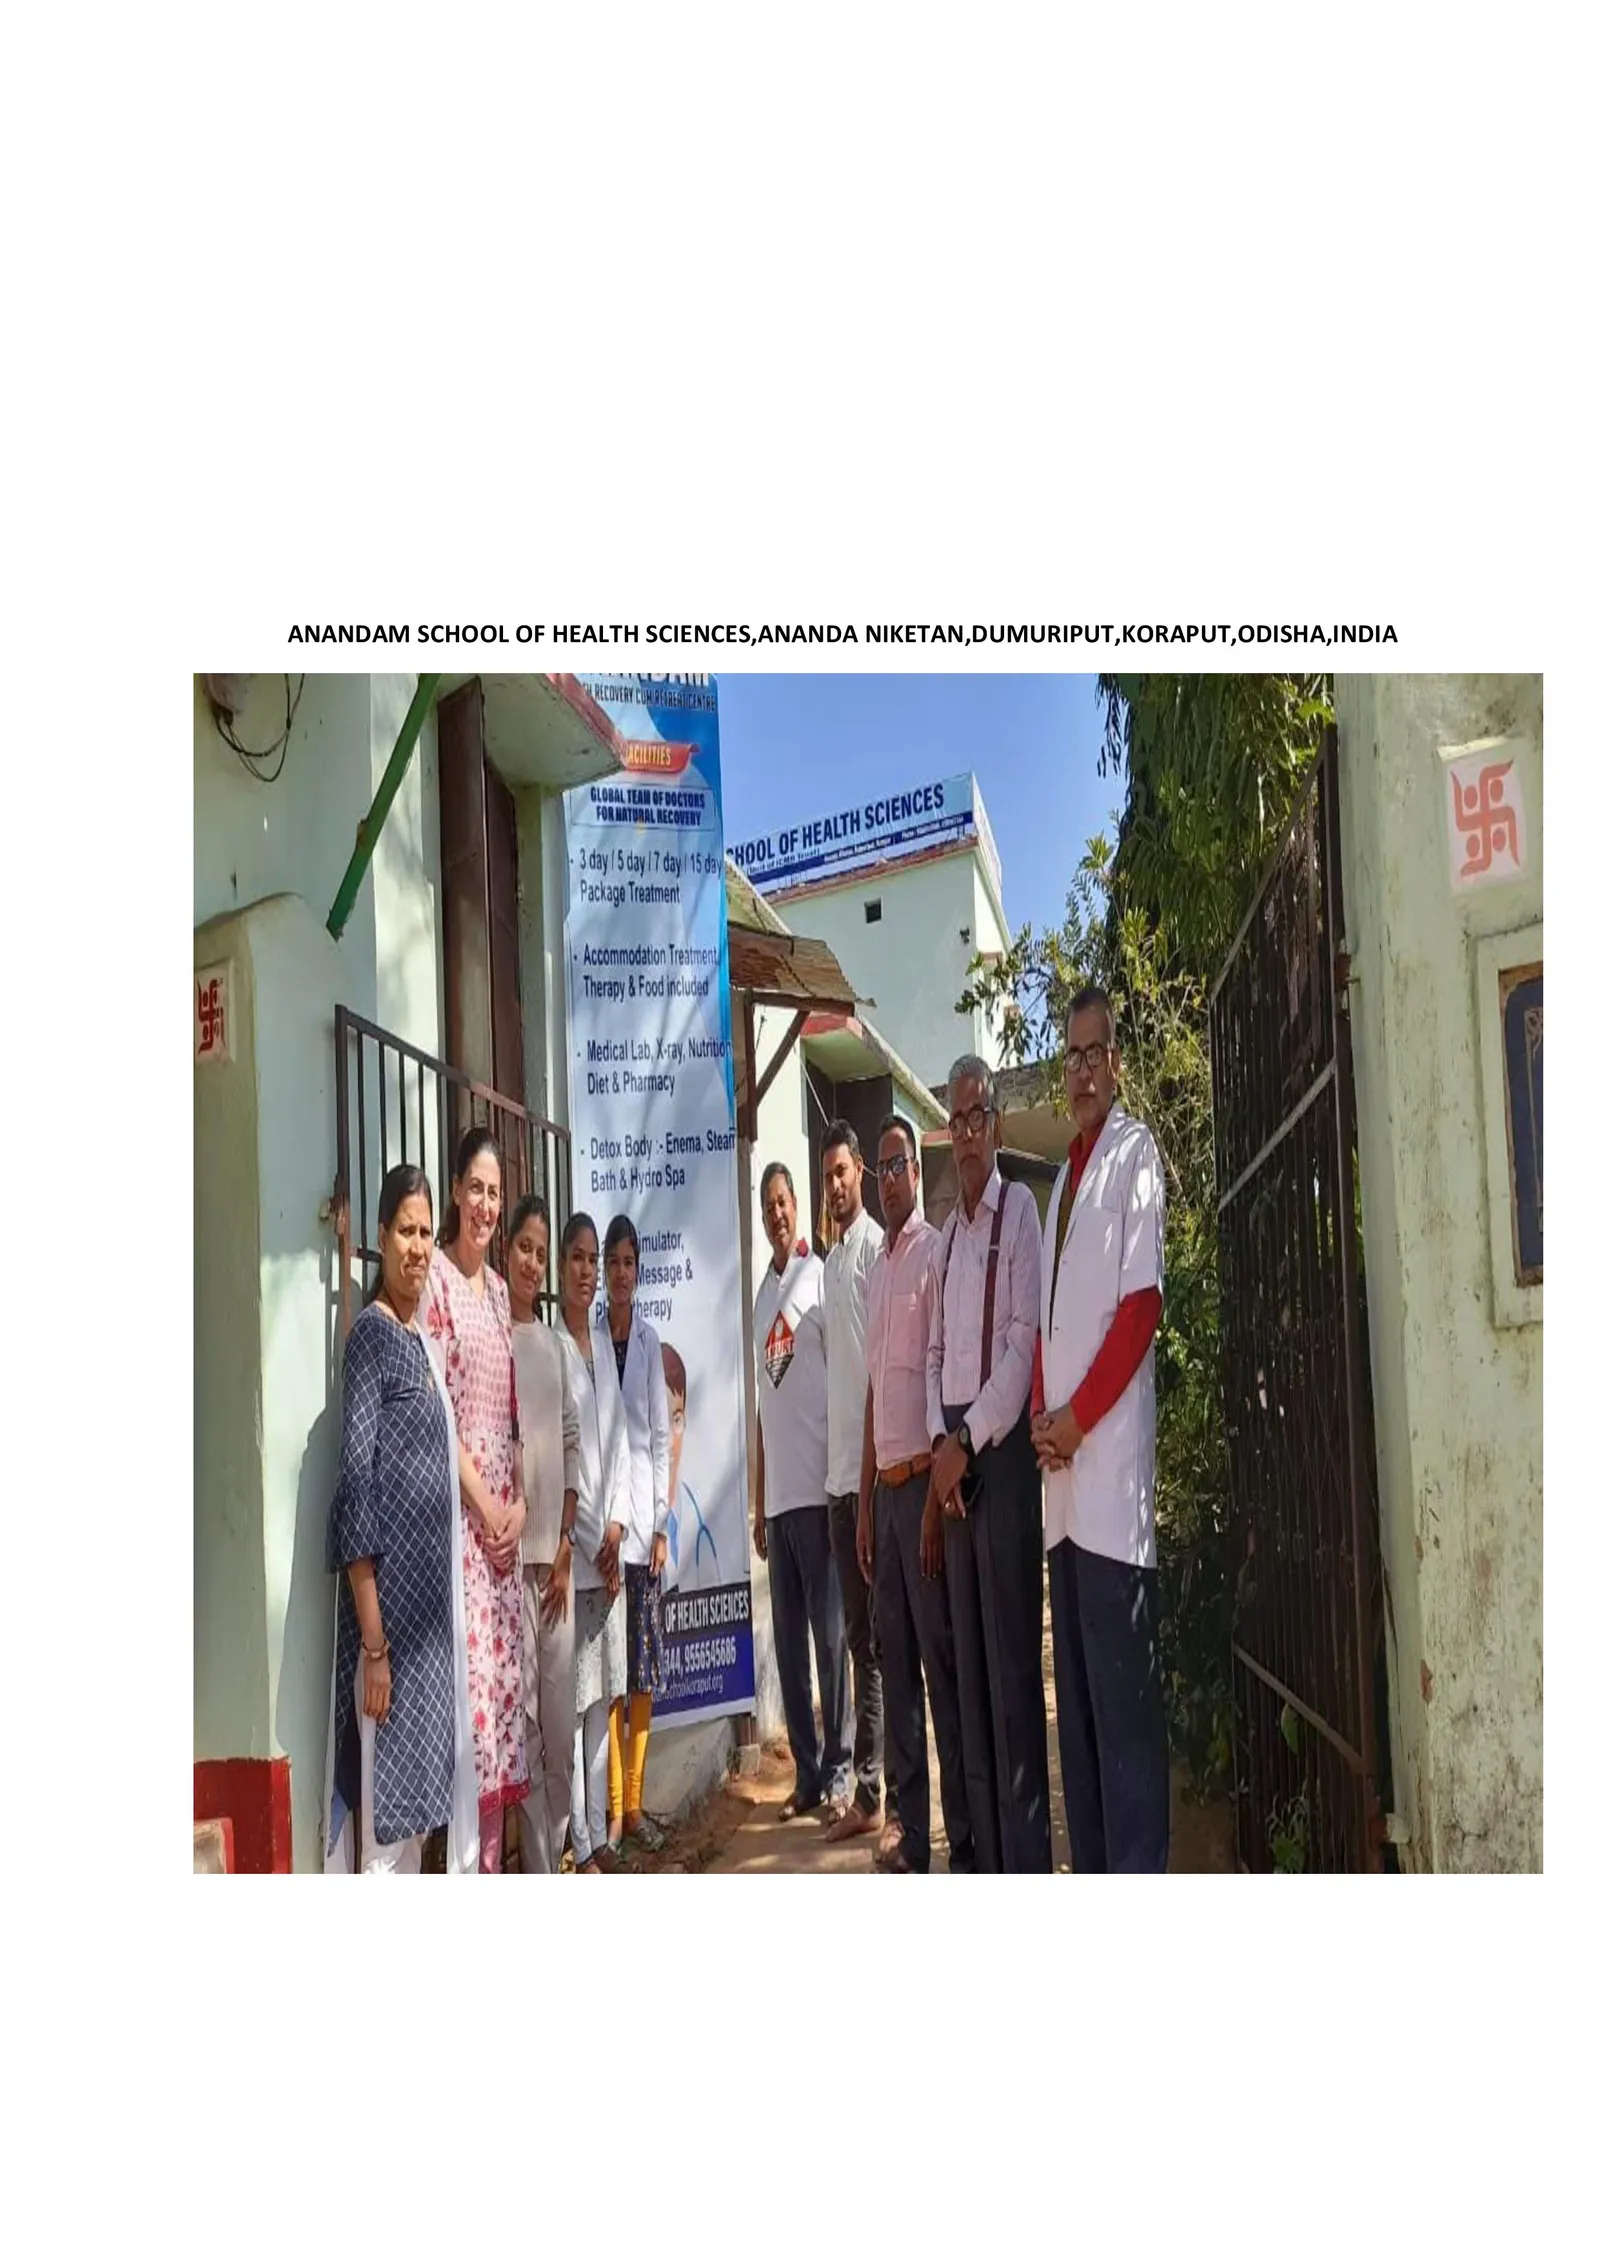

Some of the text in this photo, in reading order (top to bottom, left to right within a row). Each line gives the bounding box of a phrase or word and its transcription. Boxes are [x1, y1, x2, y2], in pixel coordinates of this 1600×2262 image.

[594, 684, 634, 703] RECOVERY
[635, 687, 651, 705] CUM
[626, 743, 671, 766] ACILITIES
[590, 786, 705, 809] GLOBAL TEAM OF DOCTORS
[596, 805, 702, 826] FOR NATURAL RECOVERY
[779, 829, 799, 856] OF
[802, 809, 861, 849] HEALTH
[864, 783, 945, 831] SCIENCES
[580, 850, 587, 870] 3
[589, 849, 609, 876] day
[617, 851, 624, 871] 5
[626, 850, 646, 877] day
[653, 852, 660, 872] 7
[663, 851, 681, 878] day
[690, 853, 701, 874] 15
[704, 853, 722, 880] day
[580, 879, 681, 908] Package Treatment
[583, 943, 667, 966] Accommodation
[583, 975, 709, 1003] Therapy & Food included
[587, 1039, 628, 1062] Medical
[587, 1071, 675, 1097] Diet & Pharmacy
[590, 1137, 622, 1160] Detox
[624, 1134, 653, 1161] Body
[666, 1131, 704, 1155] Enema,
[591, 1164, 686, 1194] Bath & Hydro Spa
[685, 1257, 693, 1281] &
[665, 1590, 749, 1634] OF HEALTH SCIENCES
